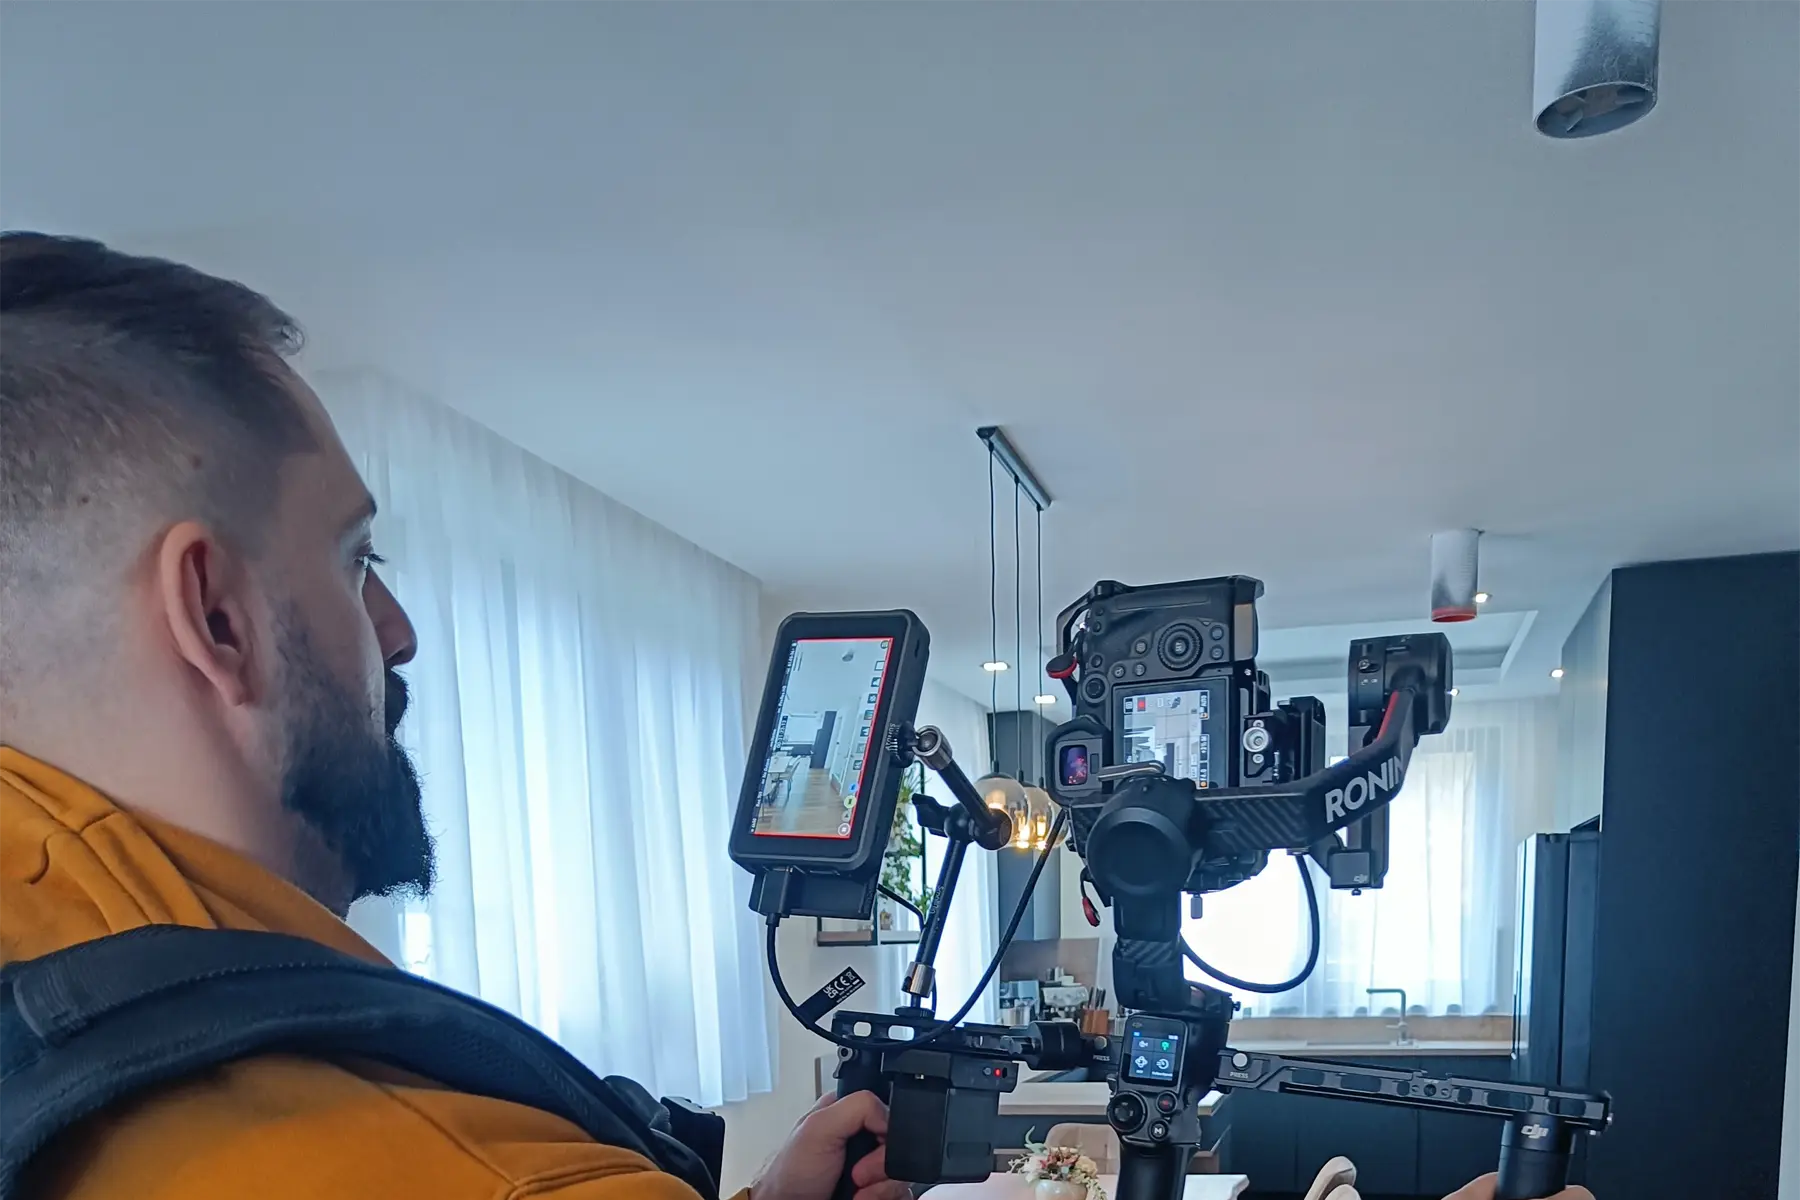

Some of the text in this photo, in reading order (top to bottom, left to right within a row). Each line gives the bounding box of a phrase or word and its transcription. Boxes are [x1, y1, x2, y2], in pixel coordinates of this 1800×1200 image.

[1325, 755, 1404, 824] RONIN
[1092, 1054, 1110, 1062] PRESS
[1229, 1071, 1249, 1079] PRESS
